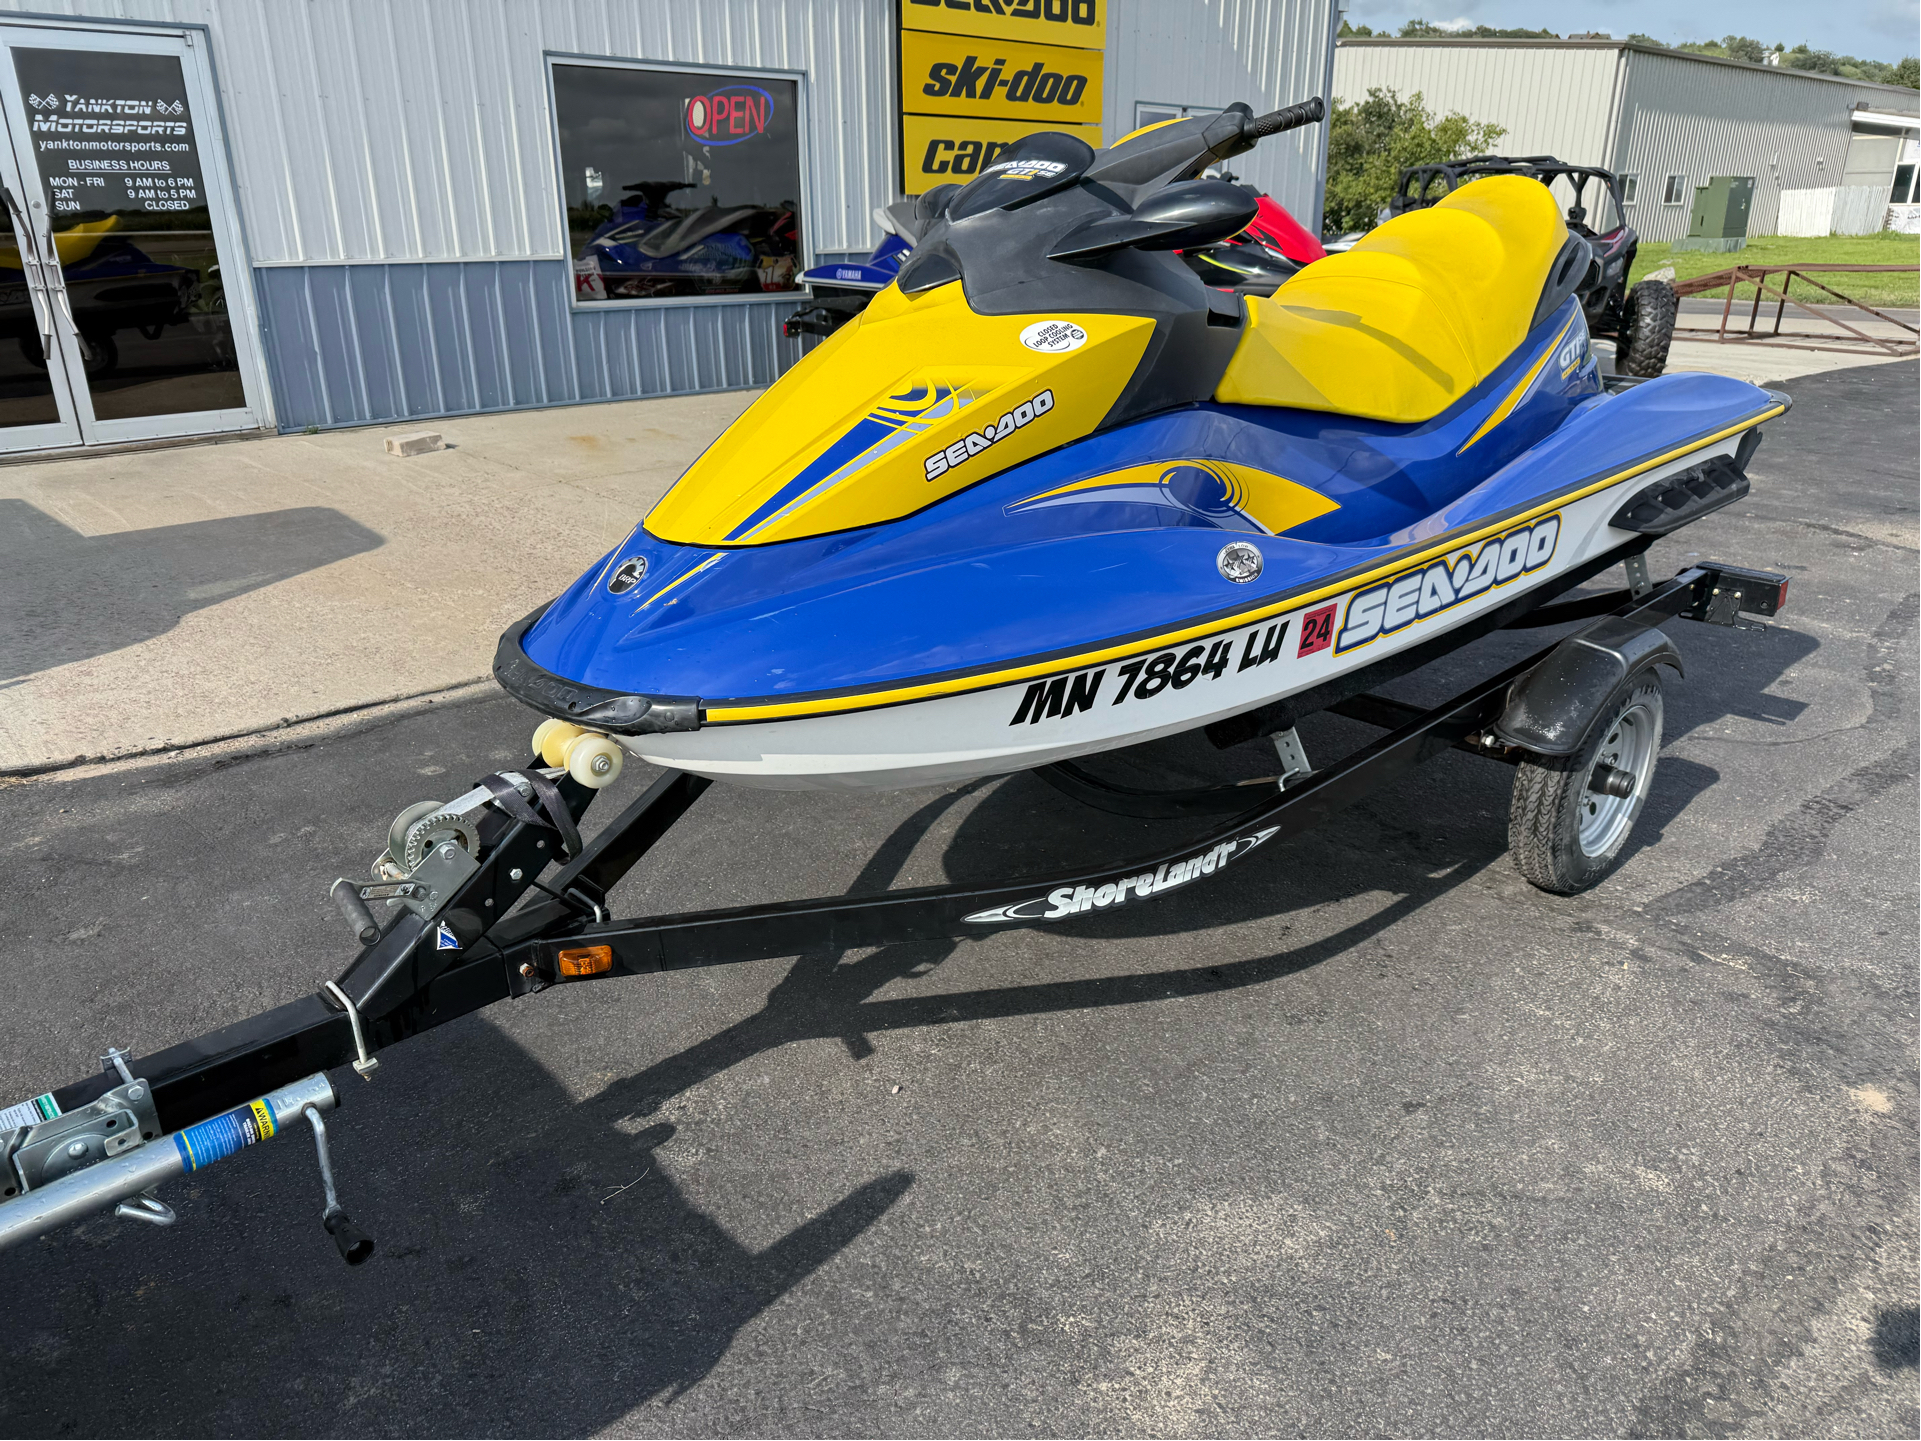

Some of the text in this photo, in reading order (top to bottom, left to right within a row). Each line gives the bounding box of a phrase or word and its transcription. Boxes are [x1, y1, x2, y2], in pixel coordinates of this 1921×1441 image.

[922, 55, 1088, 106] ski-doo
[64, 94, 152, 115] YANKTON
[688, 96, 766, 136] OPEN
[33, 114, 187, 135] MOTORSPORTS
[39, 139, 189, 153] yanktonmotorsports.com
[67, 159, 171, 171] BUSINESS HOURS
[49, 177, 79, 187] MON
[86, 177, 105, 187] FRI
[125, 177, 133, 187] 9
[136, 177, 154, 187] AM
[155, 177, 167, 187] to
[168, 177, 176, 188] 6
[177, 178, 194, 188] PM
[53, 188, 197, 199] SAT 9 AM to 5 PM
[56, 200, 190, 211] SUN CLOSED
[1033, 336, 1048, 347] LOOP
[1048, 323, 1073, 338] COOLING
[1037, 323, 1058, 337] CLOSED
[1047, 333, 1070, 347] SYSTEM
[618, 573, 637, 584] BRP
[1300, 613, 1331, 650] 24
[1010, 620, 1290, 726] MN 7864 LU
